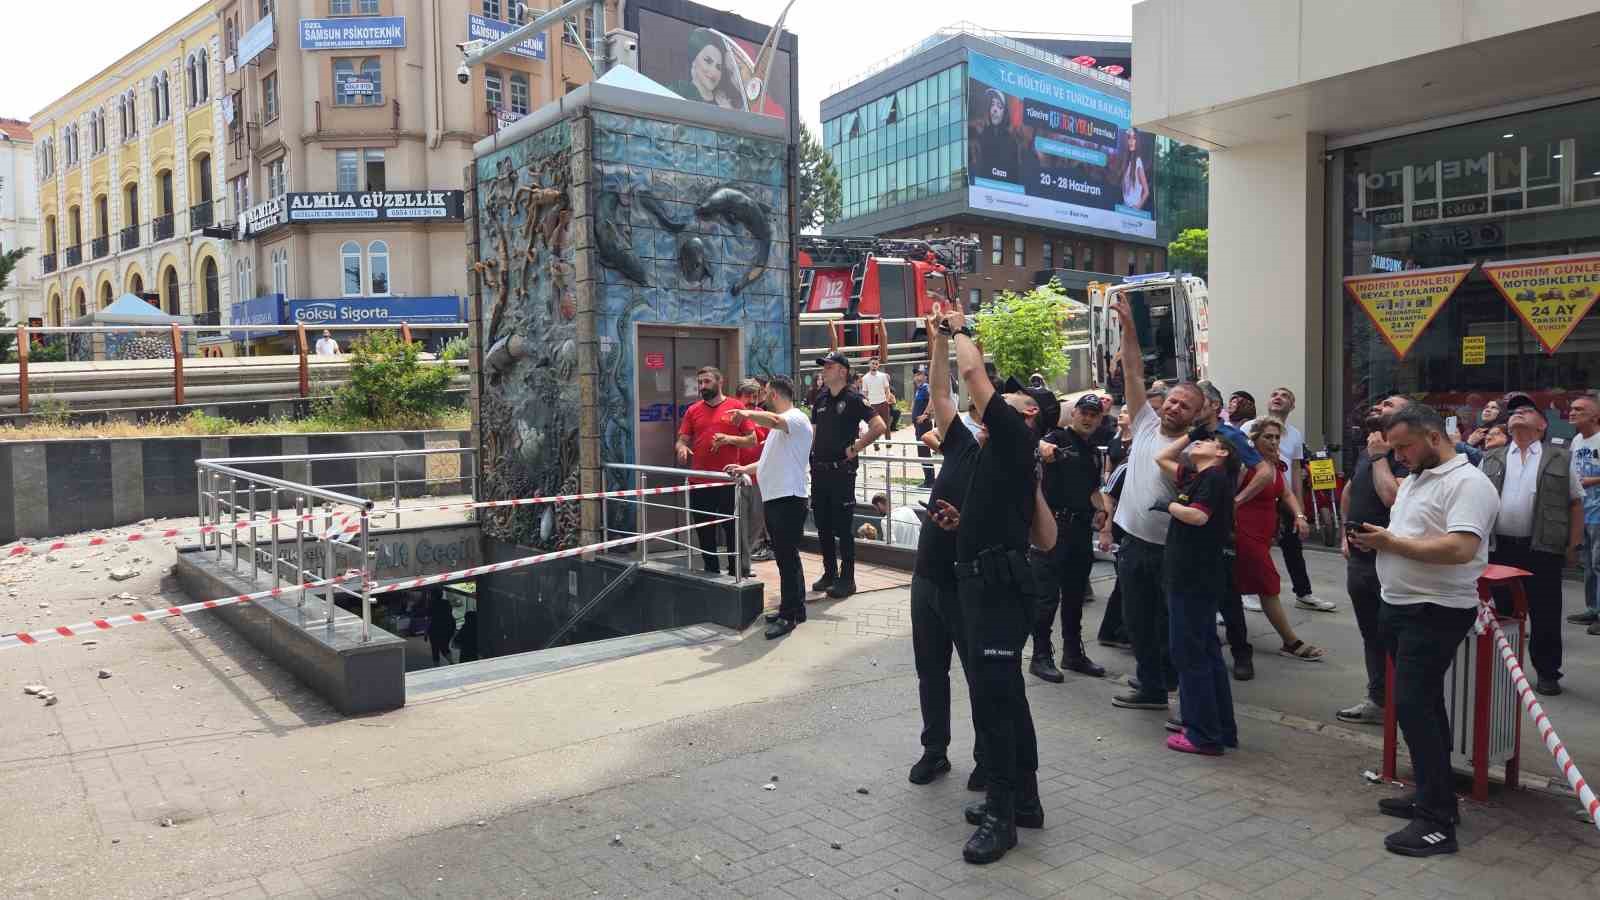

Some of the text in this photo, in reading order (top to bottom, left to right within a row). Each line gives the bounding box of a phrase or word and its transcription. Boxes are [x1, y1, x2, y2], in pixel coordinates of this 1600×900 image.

[305, 25, 401, 41] SAMSUN PSİKOTEKNİK
[471, 24, 499, 40] SAMSUN
[1018, 74, 1052, 95] KÜLTÜR
[1053, 85, 1064, 98] VE
[1040, 172, 1051, 185] 20
[1058, 176, 1068, 189] 28
[1069, 178, 1101, 196] Haziran
[291, 190, 446, 208] ALMİLA GÜZELLİK
[1497, 266, 1550, 279] İNDİRİM
[825, 280, 844, 297] 112
[1403, 274, 1457, 288] GÜNLERİ
[1360, 291, 1389, 300] BEYAZ
[340, 305, 388, 322] Sigorta
[1531, 304, 1576, 317] 24 AY
